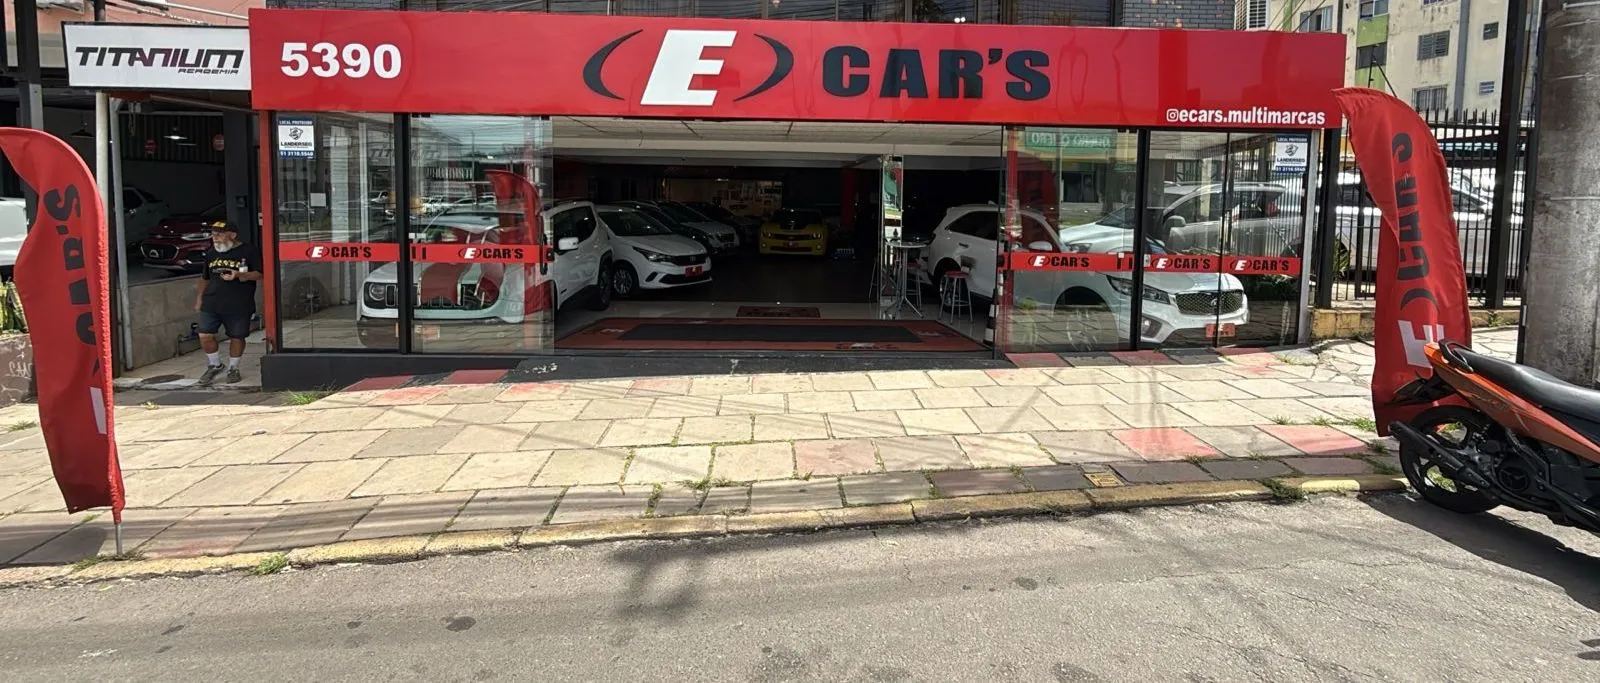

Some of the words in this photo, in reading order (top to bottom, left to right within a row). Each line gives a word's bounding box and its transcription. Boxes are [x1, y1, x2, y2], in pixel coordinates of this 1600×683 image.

[75, 46, 244, 68] TITANIUM
[280, 42, 402, 79] 5390
[821, 44, 1052, 101] CAR'S
[1178, 106, 1326, 125] ecars.multimarcas
[331, 246, 372, 258] CAR'S
[481, 248, 524, 260] CAR'S
[1050, 256, 1090, 268] CAR'S
[1173, 258, 1211, 270] CAR'S
[1252, 259, 1290, 272] CAR'S
